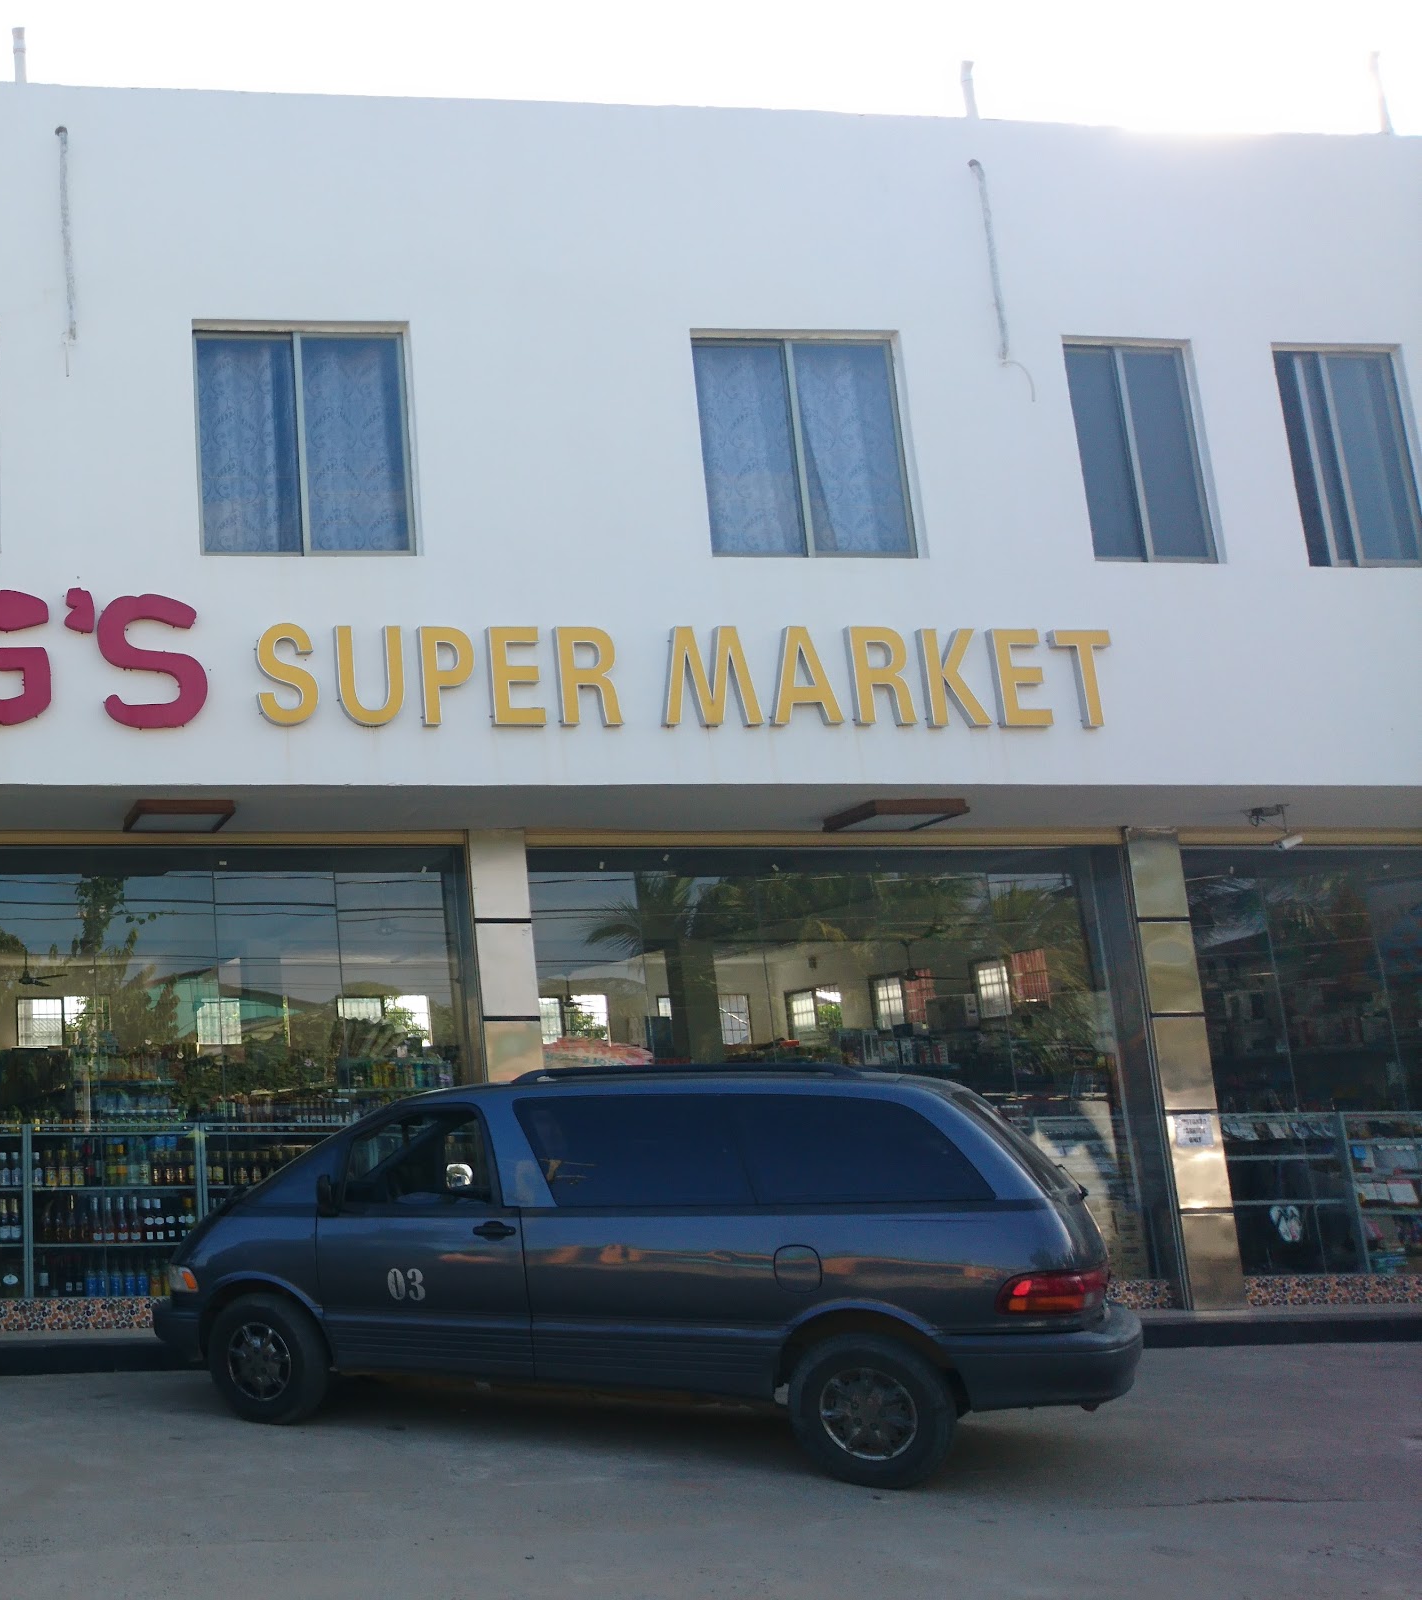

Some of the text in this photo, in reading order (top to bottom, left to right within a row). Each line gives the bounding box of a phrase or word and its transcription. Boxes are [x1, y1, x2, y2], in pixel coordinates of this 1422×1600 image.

[255, 622, 623, 728] SUPER
[661, 626, 1112, 728] MARKET
[386, 1267, 426, 1302] 03
